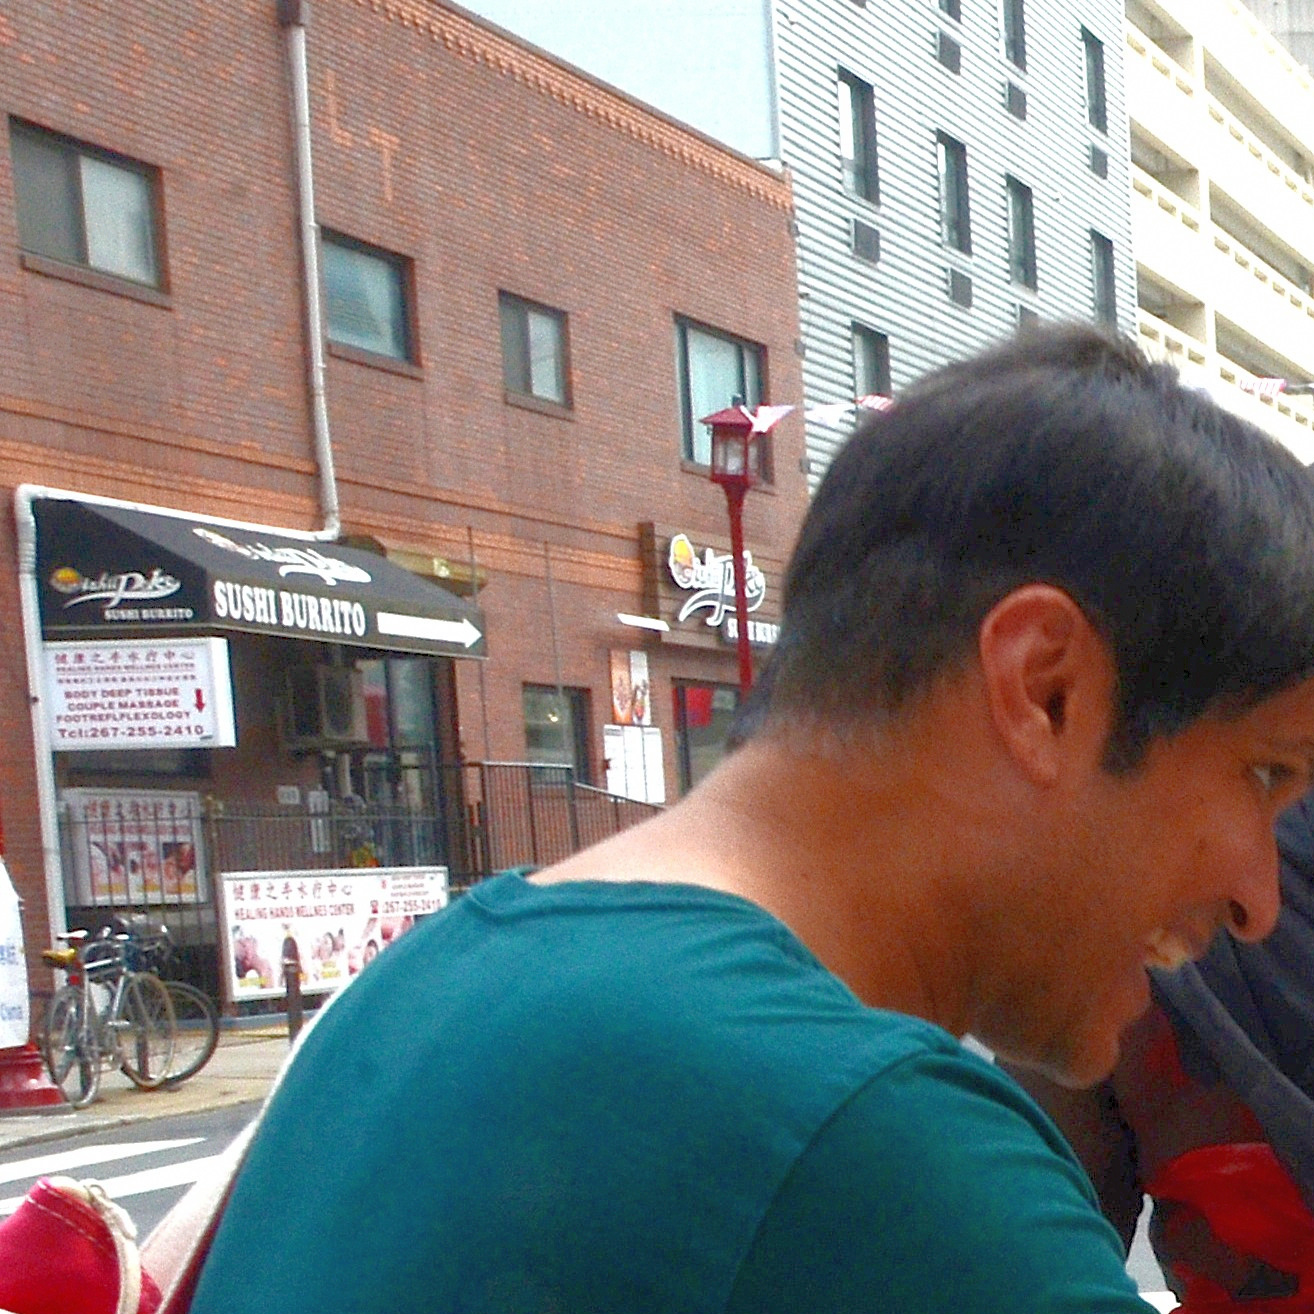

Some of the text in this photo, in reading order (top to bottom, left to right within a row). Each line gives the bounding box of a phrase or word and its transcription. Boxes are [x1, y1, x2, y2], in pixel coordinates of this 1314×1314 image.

[104, 608, 193, 620] SUSHI BURRITO
[213, 580, 366, 637] SUSHI BURRITO
[65, 687, 179, 699] BODY DEEP TISSUE
[68, 699, 179, 711] COUPLE MASSAGE
